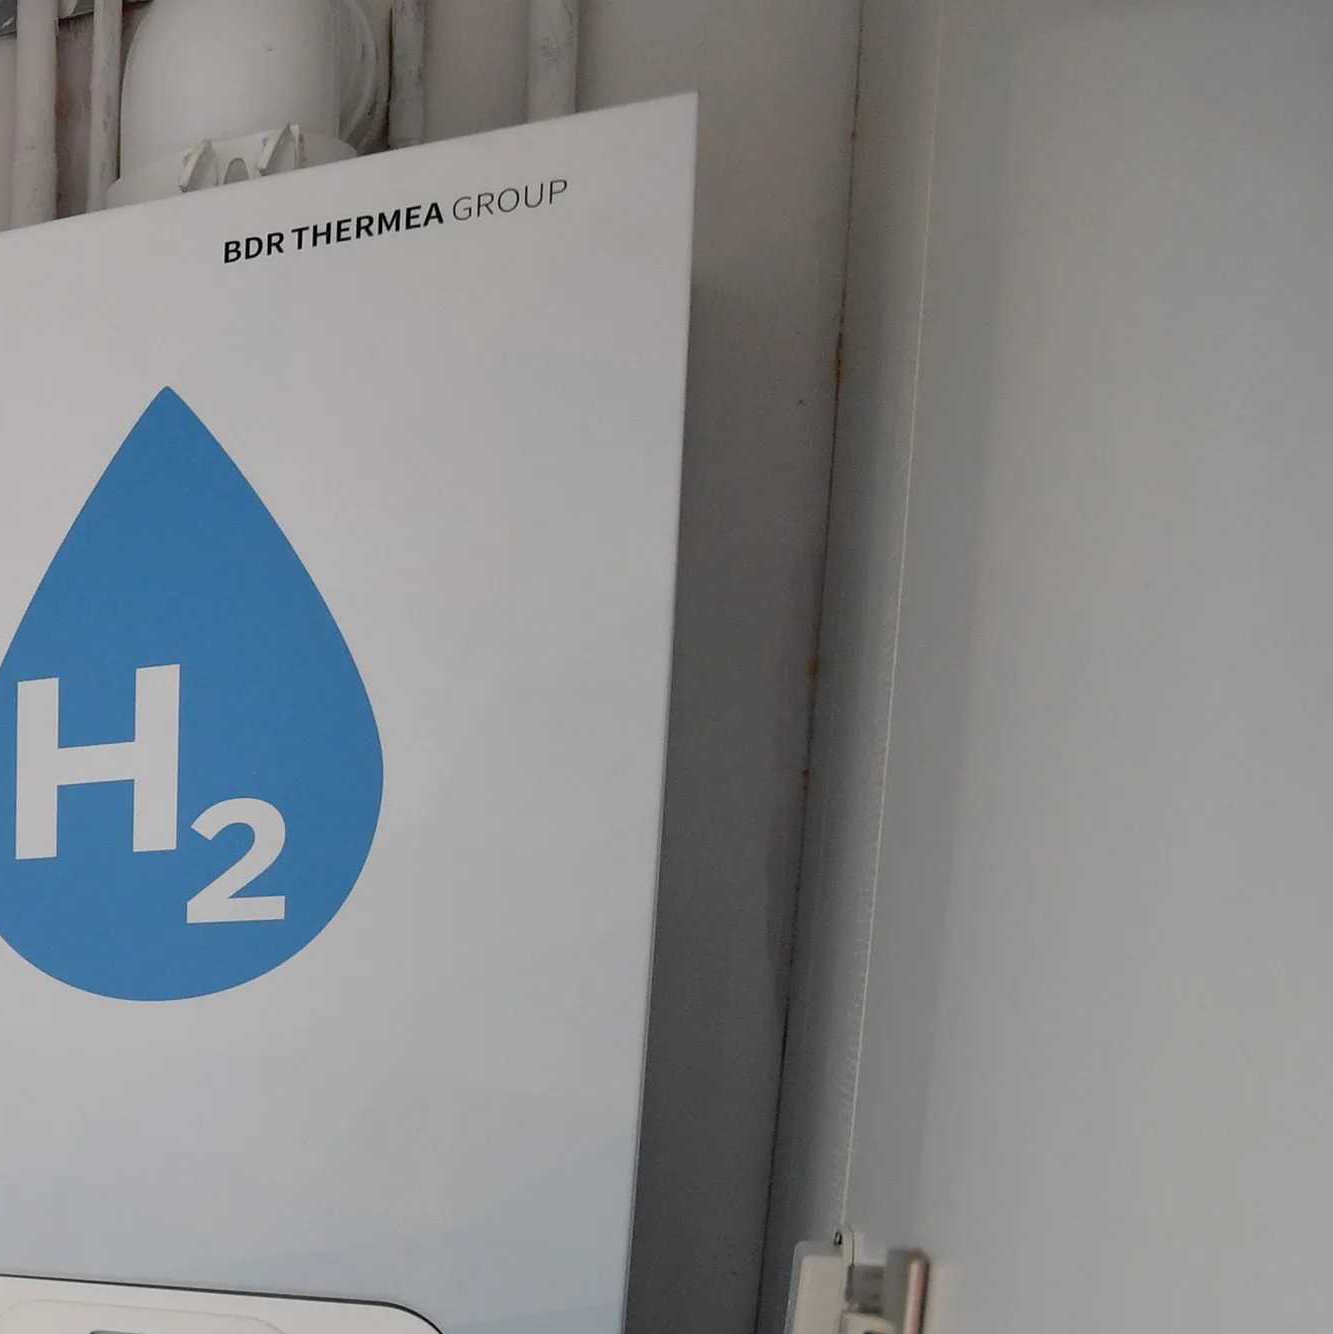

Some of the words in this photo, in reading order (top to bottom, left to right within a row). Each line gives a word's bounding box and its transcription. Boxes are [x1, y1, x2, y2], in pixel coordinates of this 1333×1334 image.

[223, 231, 285, 264] BDR
[290, 201, 445, 251] THERMEA
[452, 178, 569, 222] GROUP
